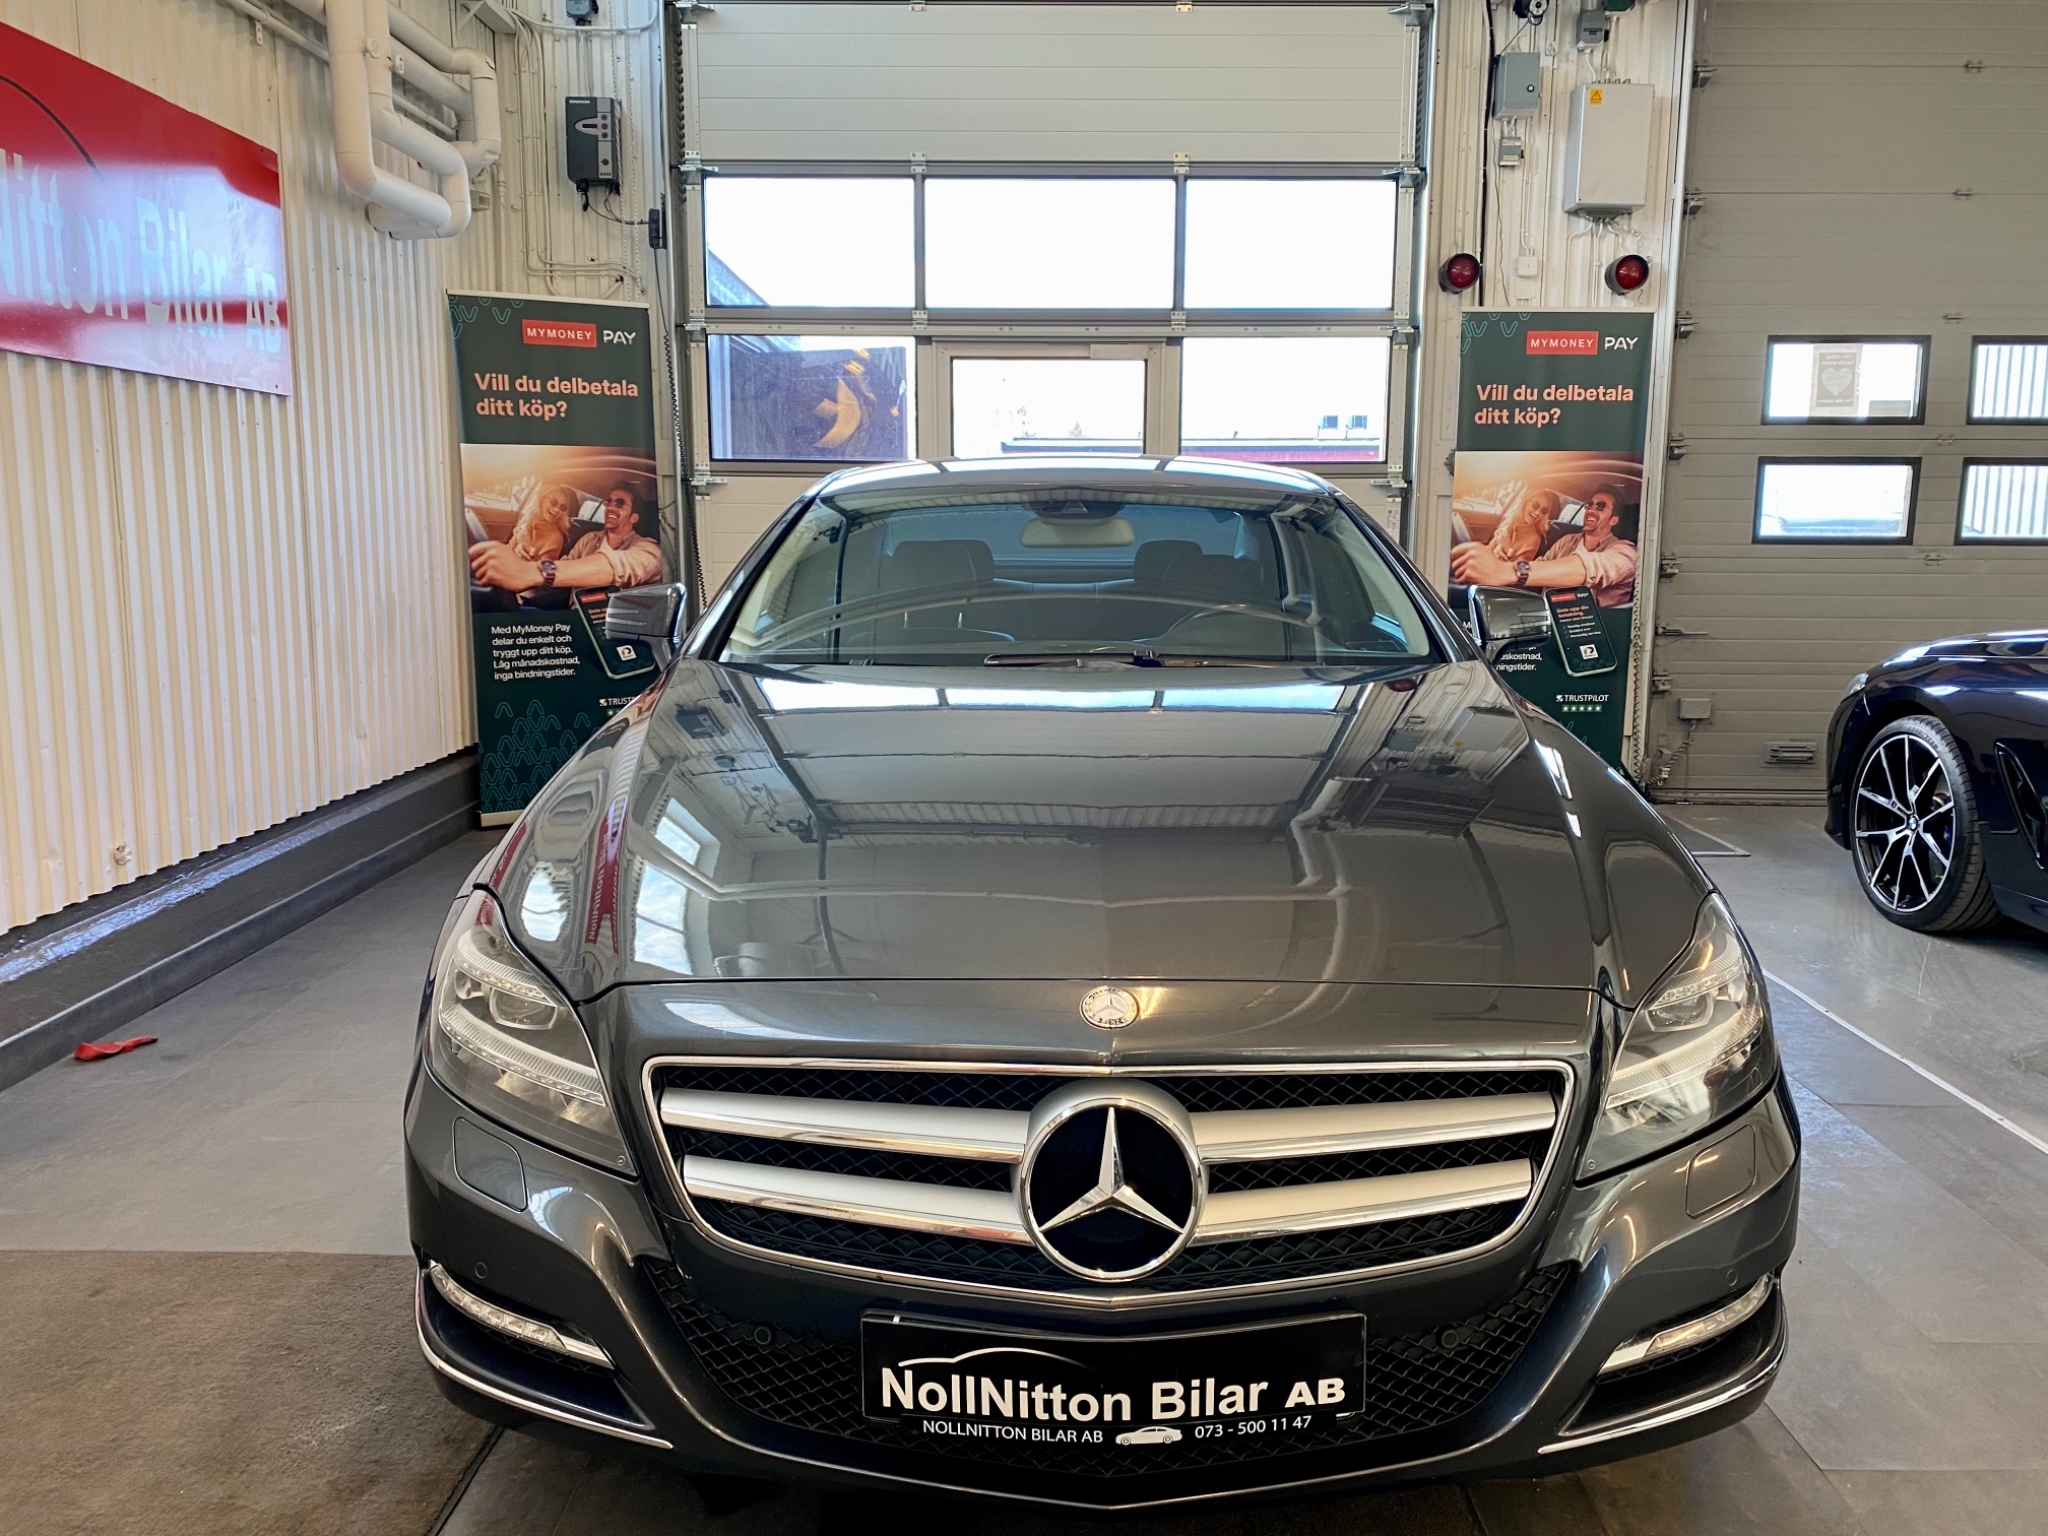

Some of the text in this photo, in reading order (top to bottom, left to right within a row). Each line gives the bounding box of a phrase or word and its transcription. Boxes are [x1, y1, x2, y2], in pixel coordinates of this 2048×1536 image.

[136, 195, 227, 340] Bilar
[244, 266, 281, 354] AB
[526, 327, 637, 345] MYMONEY PAY
[1530, 336, 1639, 350] MYMONEY PAY
[473, 372, 638, 397] Vill du delbetala
[1476, 384, 1634, 401] Vill du delbetala
[475, 397, 568, 421] ditt köp?
[1474, 407, 1561, 428] ditt köp?
[491, 623, 571, 635] Med MyMoney Pay
[491, 637, 515, 646] delar
[528, 635, 555, 644] enkelt
[555, 634, 572, 643] och
[492, 645, 573, 659] tryggt upp ditt köp.
[493, 656, 580, 670] Låg månadskostnad,
[494, 668, 576, 682] inga bindningstider.
[1564, 694, 1610, 702] TRUSTPILOT
[882, 1367, 1346, 1422] NollNitton Bilar AB
[923, 1420, 1104, 1443] NOLLNITTON BILAR AB
[1195, 1424, 1224, 1439] 073
[1237, 1419, 1266, 1435] 500
[1271, 1417, 1287, 1431] 11
[1292, 1415, 1312, 1429] 47
